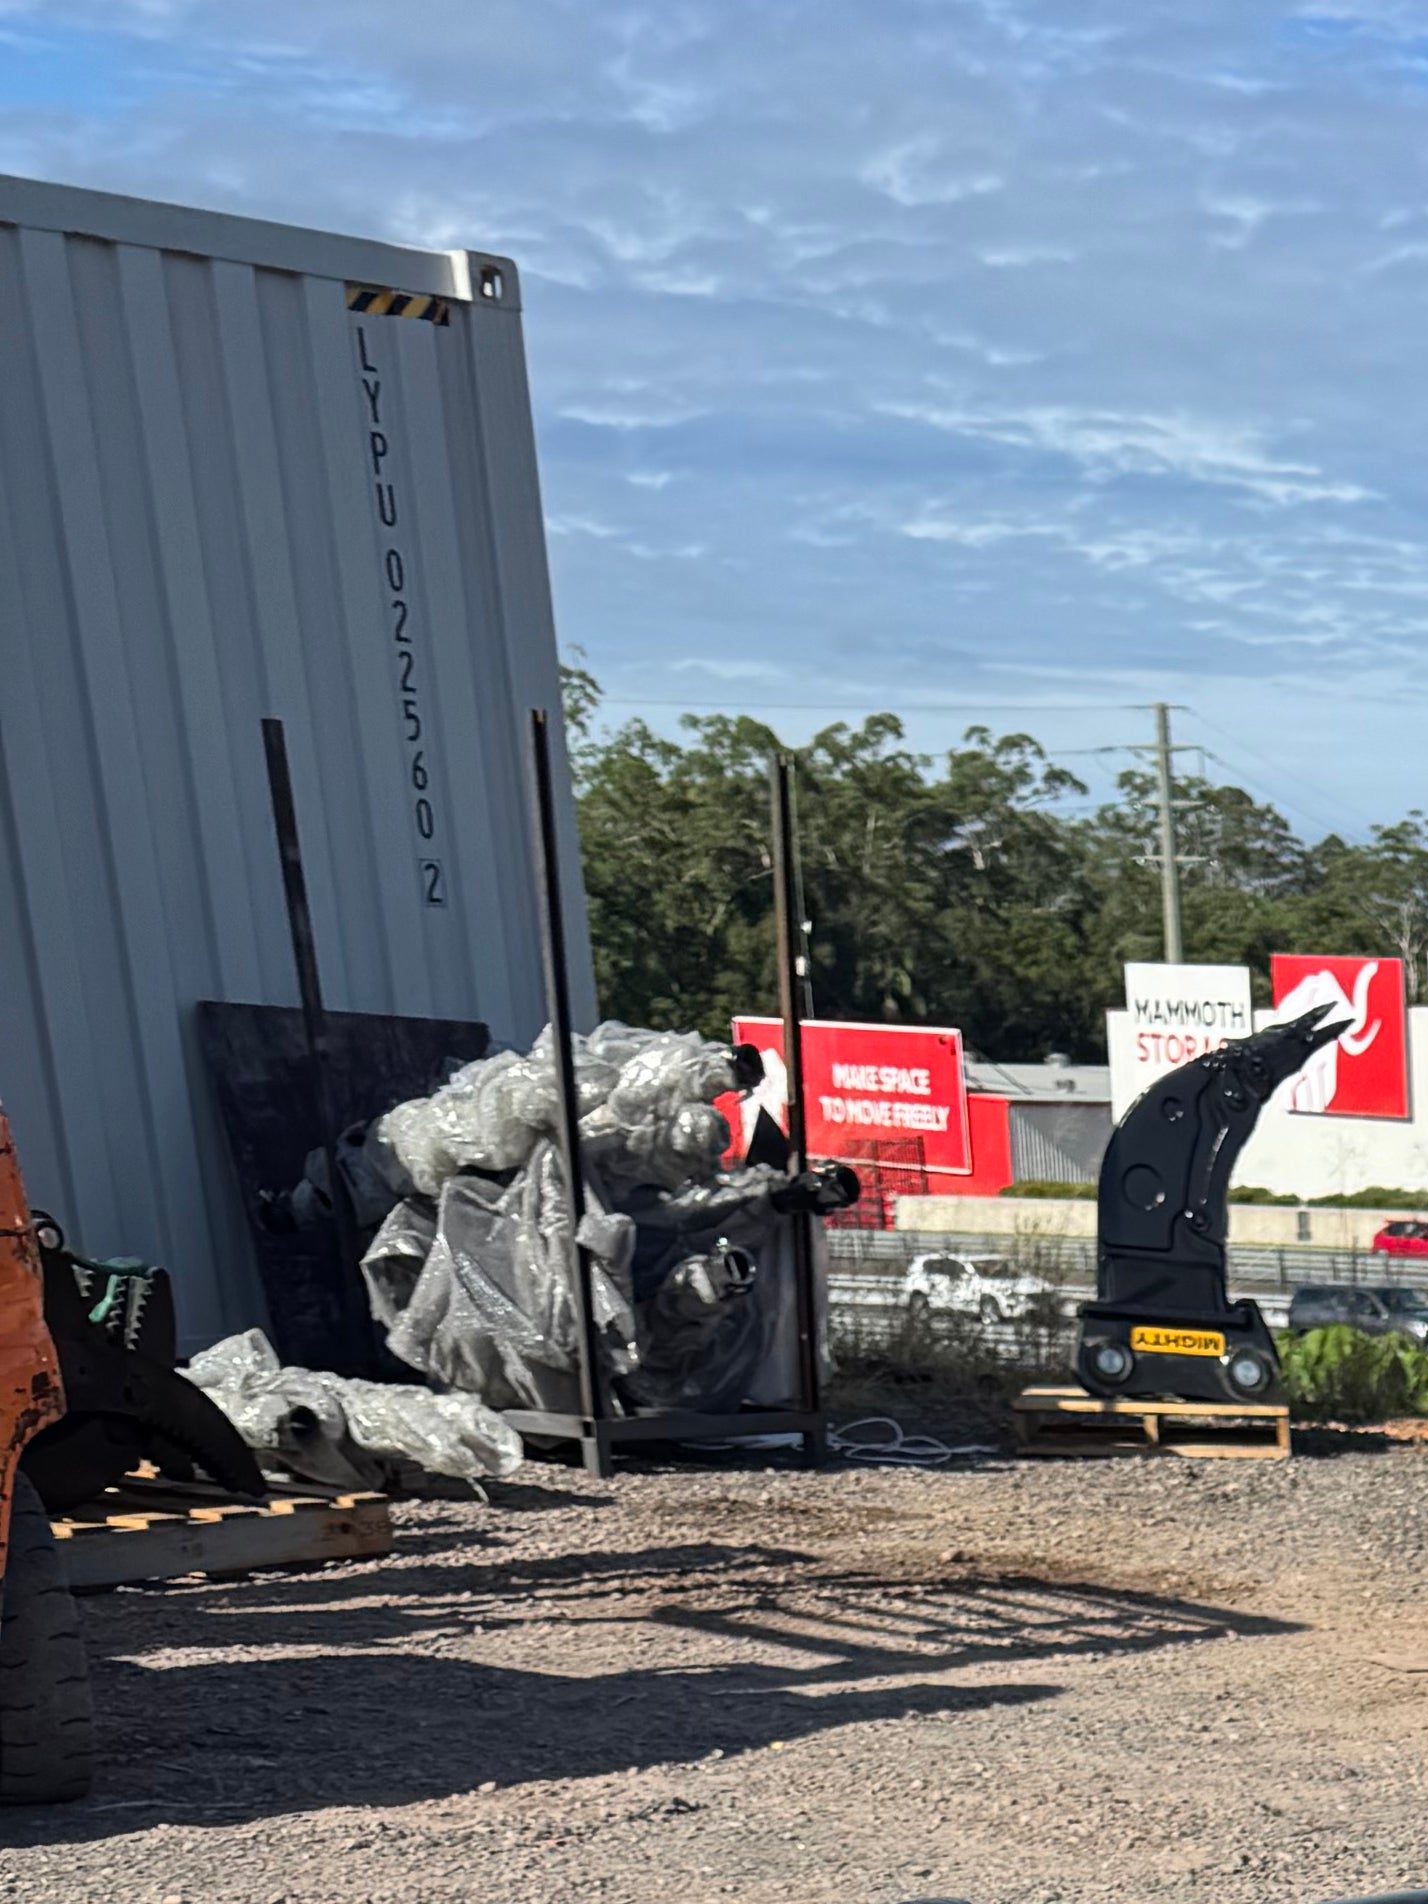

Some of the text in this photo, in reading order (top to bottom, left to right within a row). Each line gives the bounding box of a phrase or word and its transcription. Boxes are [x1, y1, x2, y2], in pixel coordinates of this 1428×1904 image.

[357, 327, 444, 903] LYPU 022560 2
[1135, 999, 1246, 1029] MAMMOTH
[1137, 1032, 1228, 1064] STOR
[832, 1063, 931, 1095] MAKE SPACE
[819, 1096, 950, 1132] TO MOVE FREELY
[1136, 1332, 1220, 1351] MIGHTY
